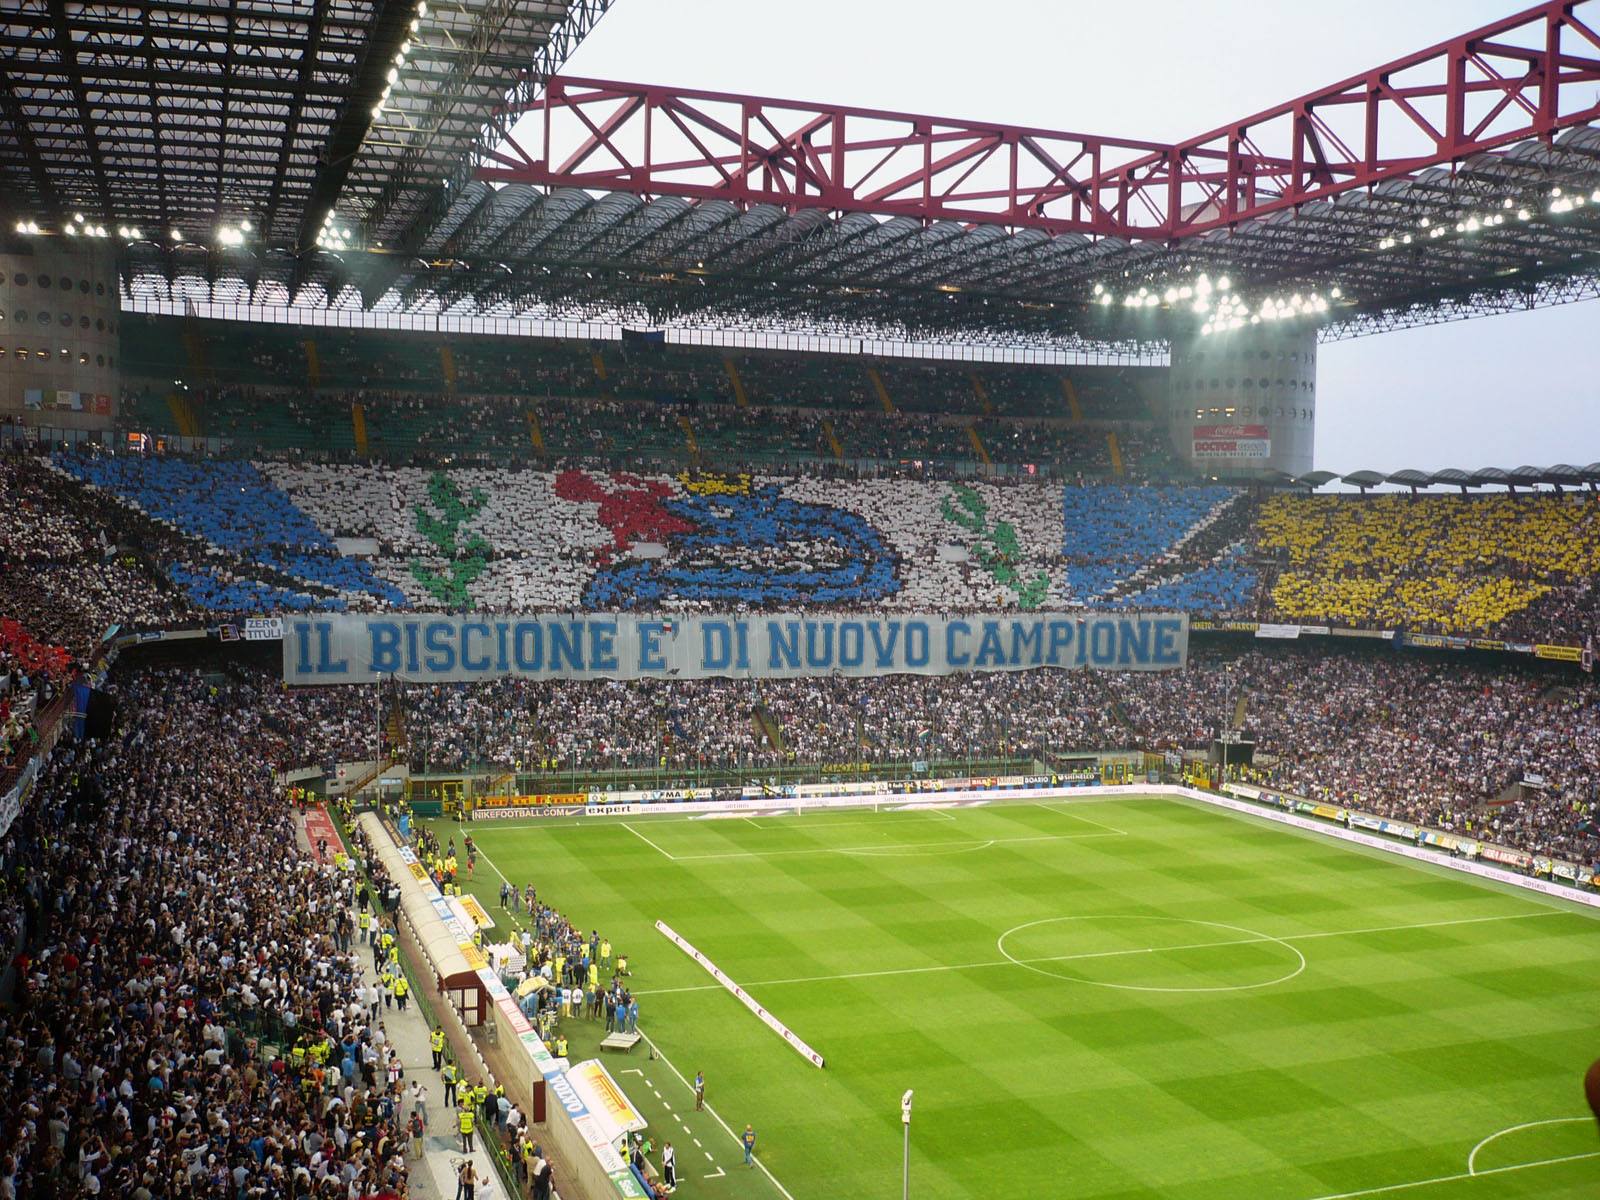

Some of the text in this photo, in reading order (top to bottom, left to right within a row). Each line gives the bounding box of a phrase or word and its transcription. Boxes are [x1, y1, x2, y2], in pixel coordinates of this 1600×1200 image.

[247, 619, 278, 628] ZERO
[247, 629, 281, 639] TITULI
[297, 622, 348, 673] IL
[368, 622, 618, 672] BISCIONE
[701, 621, 749, 670] DI
[768, 621, 929, 668] NUOVO
[946, 619, 1181, 666] CAMPIONE
[474, 808, 566, 820] NIKEFOOTBALL.COM
[588, 805, 631, 816] expert
[549, 1072, 584, 1112] VOLVO
